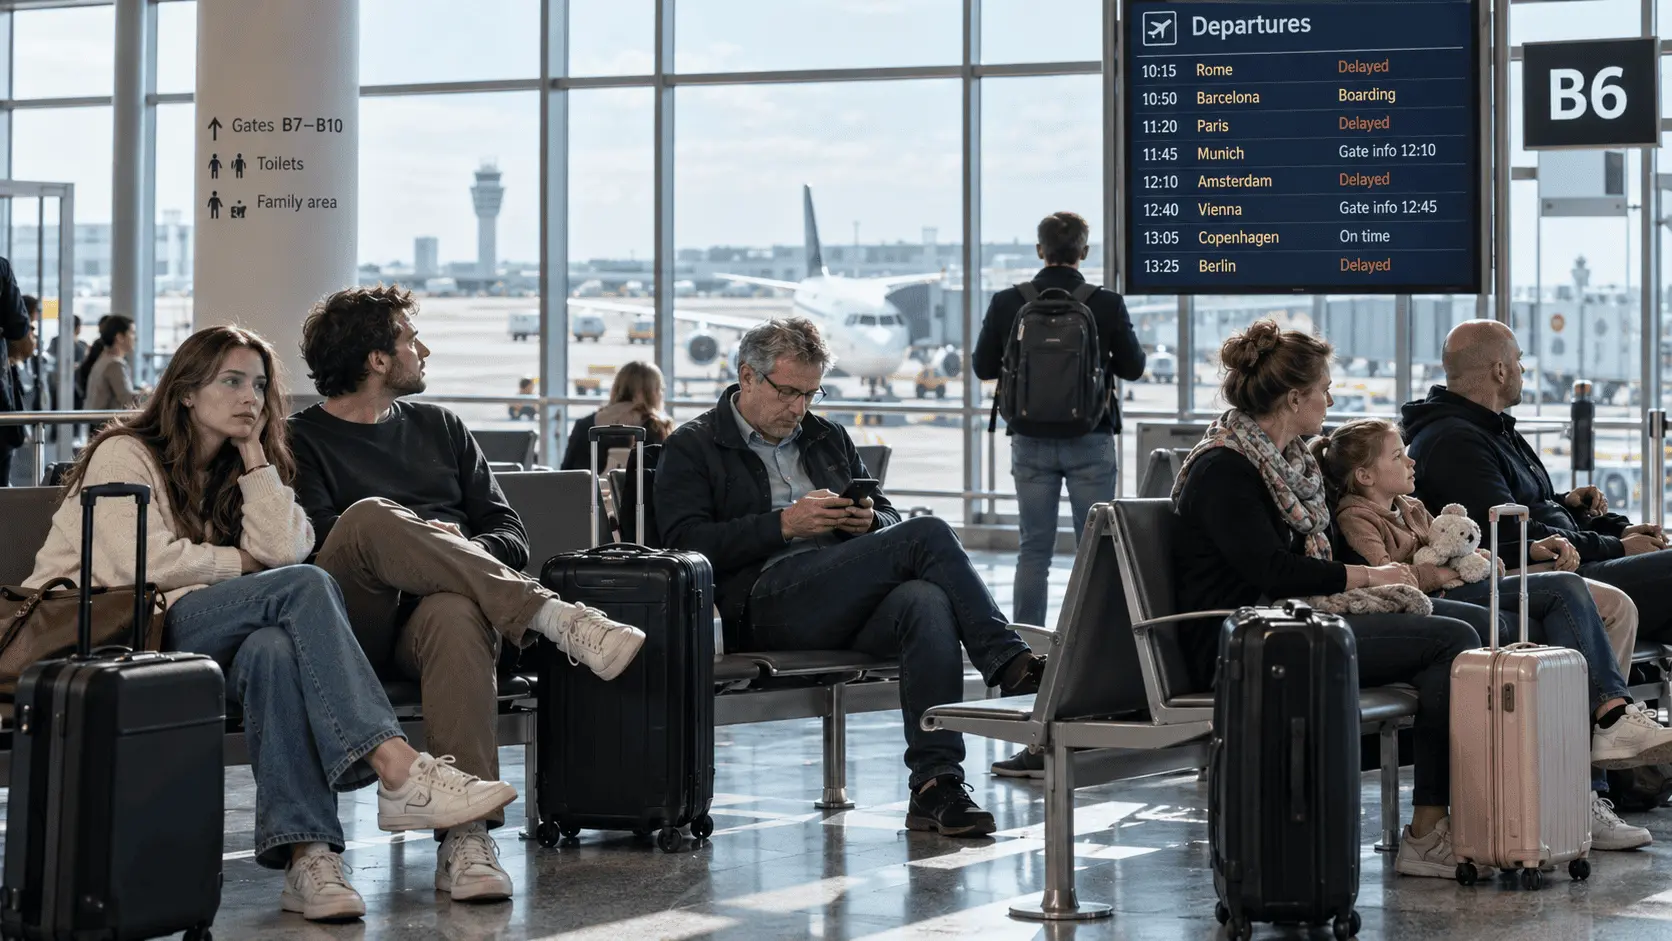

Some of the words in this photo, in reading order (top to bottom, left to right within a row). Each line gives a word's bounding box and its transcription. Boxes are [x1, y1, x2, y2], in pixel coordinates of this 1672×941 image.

[1193, 15, 1311, 40] Departures
[1142, 64, 1176, 77] 10:15
[1197, 64, 1232, 76] Rome
[1339, 59, 1388, 75] Delayed
[1143, 92, 1177, 105] 10:50
[1197, 91, 1259, 104] Barcelona
[1339, 88, 1395, 103] Boarding
[1550, 66, 1628, 121] B6
[232, 118, 274, 132] Gates
[1143, 120, 1177, 133] 11:20
[1198, 119, 1228, 132] Paris
[1339, 116, 1389, 132] Delayed
[1144, 148, 1177, 160] 11:45
[1198, 146, 1244, 160] Munich
[1339, 145, 1369, 157] Gate
[1373, 143, 1397, 157] info
[1401, 143, 1436, 156] 12:10
[257, 156, 304, 170] Toilets
[1144, 175, 1178, 188] 12:10
[1198, 174, 1272, 187] Amsterdam
[1340, 172, 1389, 188] Delayed
[258, 194, 303, 212] Family
[308, 198, 338, 208] area
[1144, 203, 1178, 216] 12:40
[1198, 203, 1241, 216] Vienna
[1340, 201, 1369, 214] Gate
[1374, 200, 1397, 213] info
[1402, 200, 1437, 213] 12:45
[1144, 231, 1179, 244] 13:05
[1199, 230, 1279, 247] Copenhagen
[1340, 230, 1357, 242] On
[1362, 229, 1390, 242] time
[1145, 260, 1179, 272] 13:25
[1200, 259, 1235, 272] Berlin
[1341, 258, 1390, 274] Delayed
